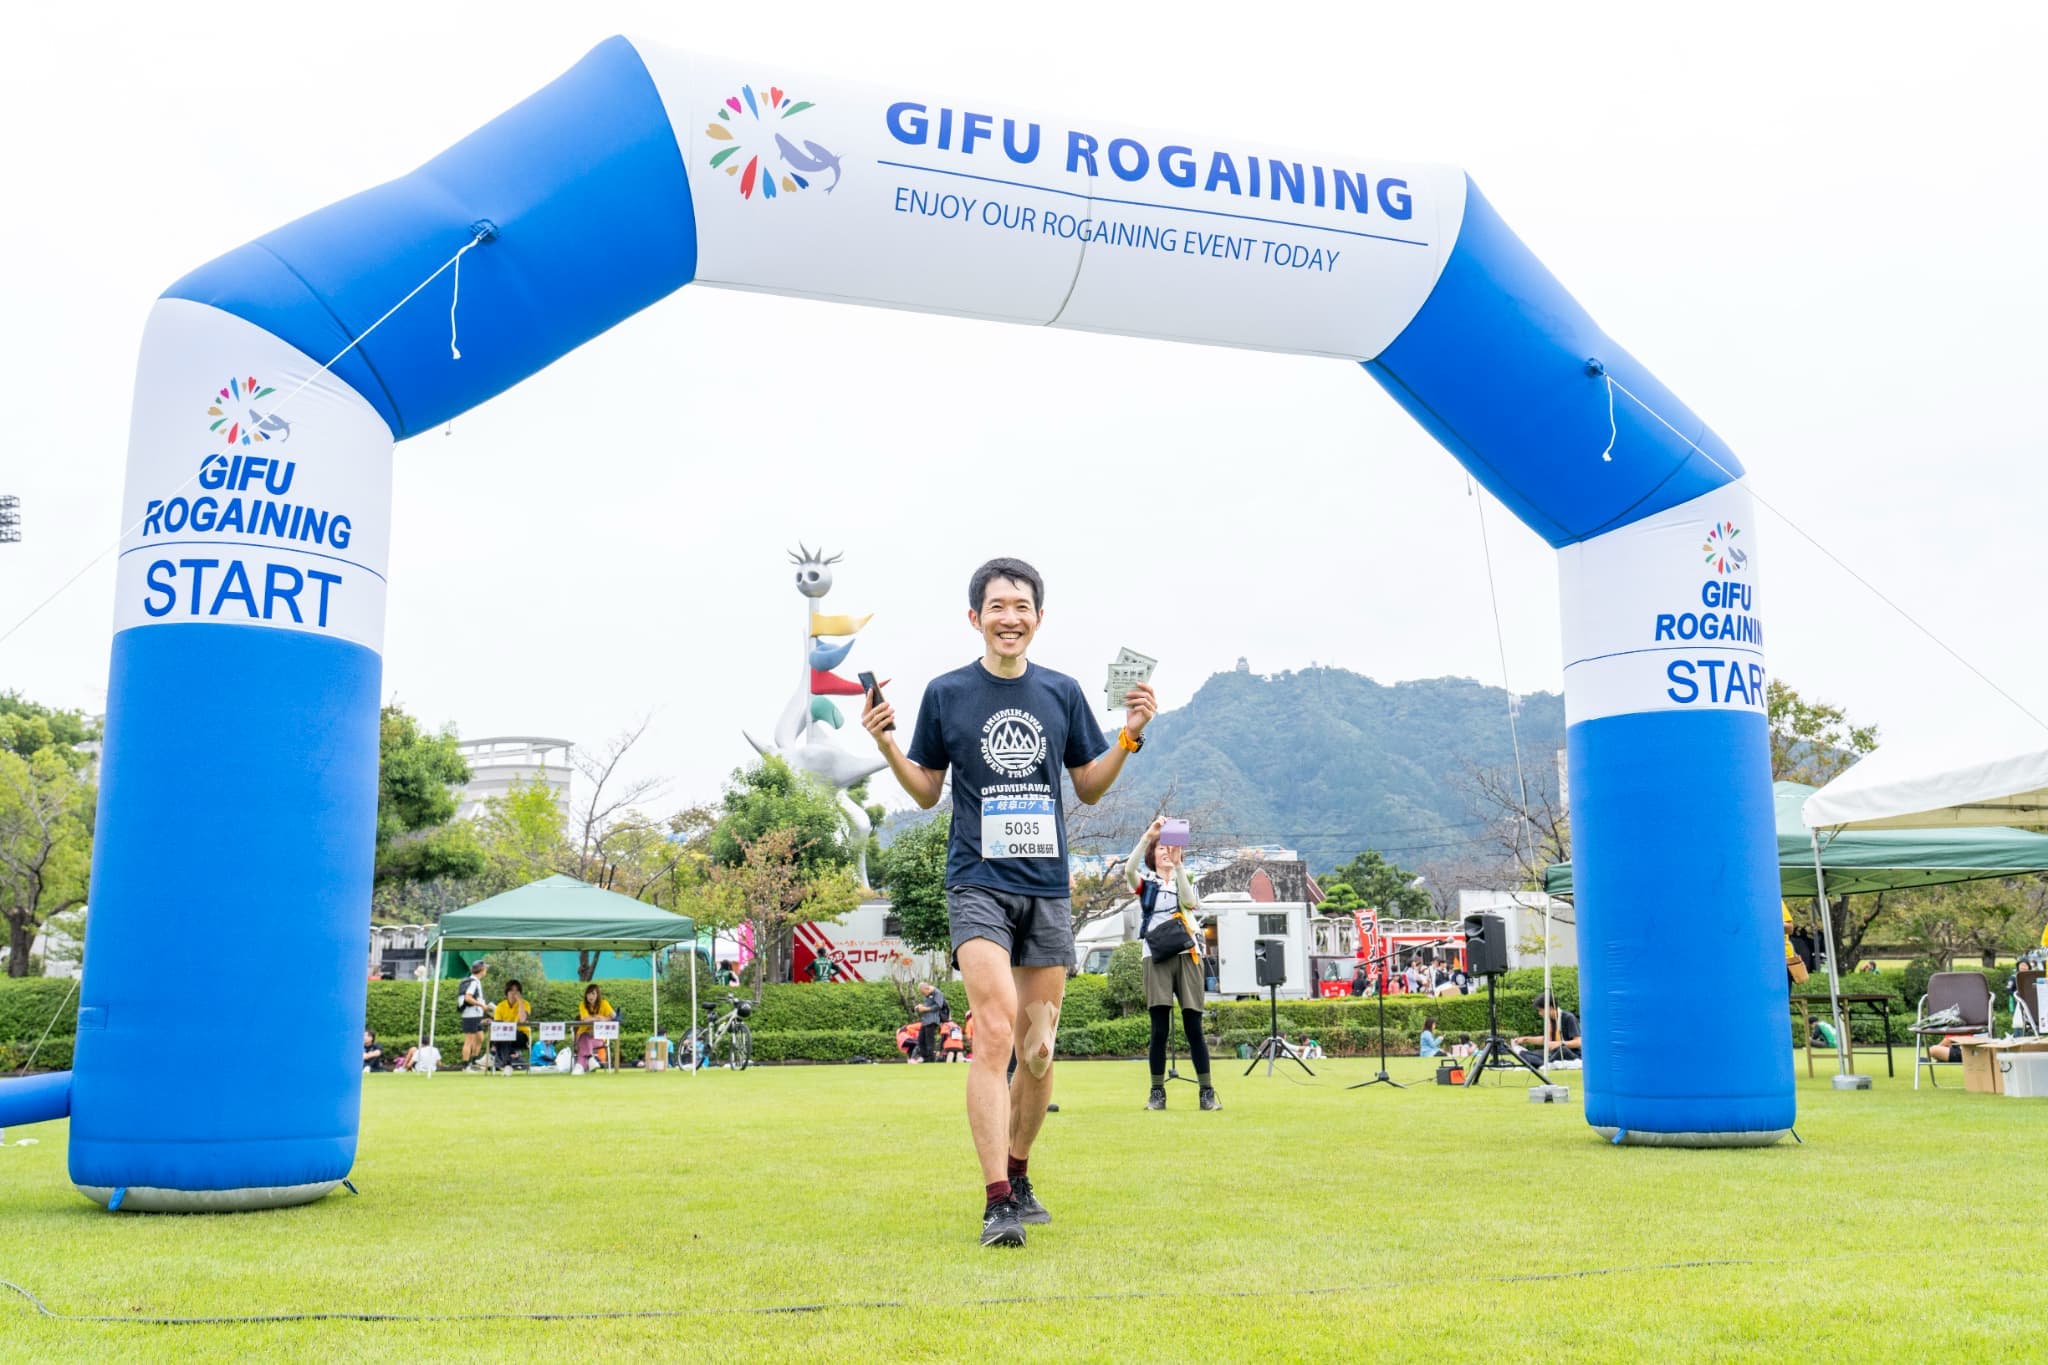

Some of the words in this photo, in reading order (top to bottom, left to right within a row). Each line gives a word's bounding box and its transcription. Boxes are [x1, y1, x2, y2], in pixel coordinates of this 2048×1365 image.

[886, 101, 1041, 165] GIFU
[1066, 130, 1413, 221] ROGAINING
[895, 186, 977, 222] ENJOY
[982, 201, 1037, 232] OUR
[1042, 211, 1178, 252] ROGAINING
[1183, 230, 1258, 262] EVENT
[1262, 240, 1341, 273] TODAY
[198, 453, 297, 496] GIFU
[142, 496, 352, 550] ROGAINING
[143, 558, 343, 628] START
[1701, 580, 1752, 612] GIFU
[1654, 612, 1763, 648] ROGAININ
[1666, 659, 1766, 708] STAR
[982, 708, 1044, 734] OKUMIKAWA
[980, 737, 1005, 776] POWER
[1007, 764, 1038, 779] TRAIL
[981, 782, 1051, 797] OKUMIKAWA
[1004, 821, 1040, 836] 5035
